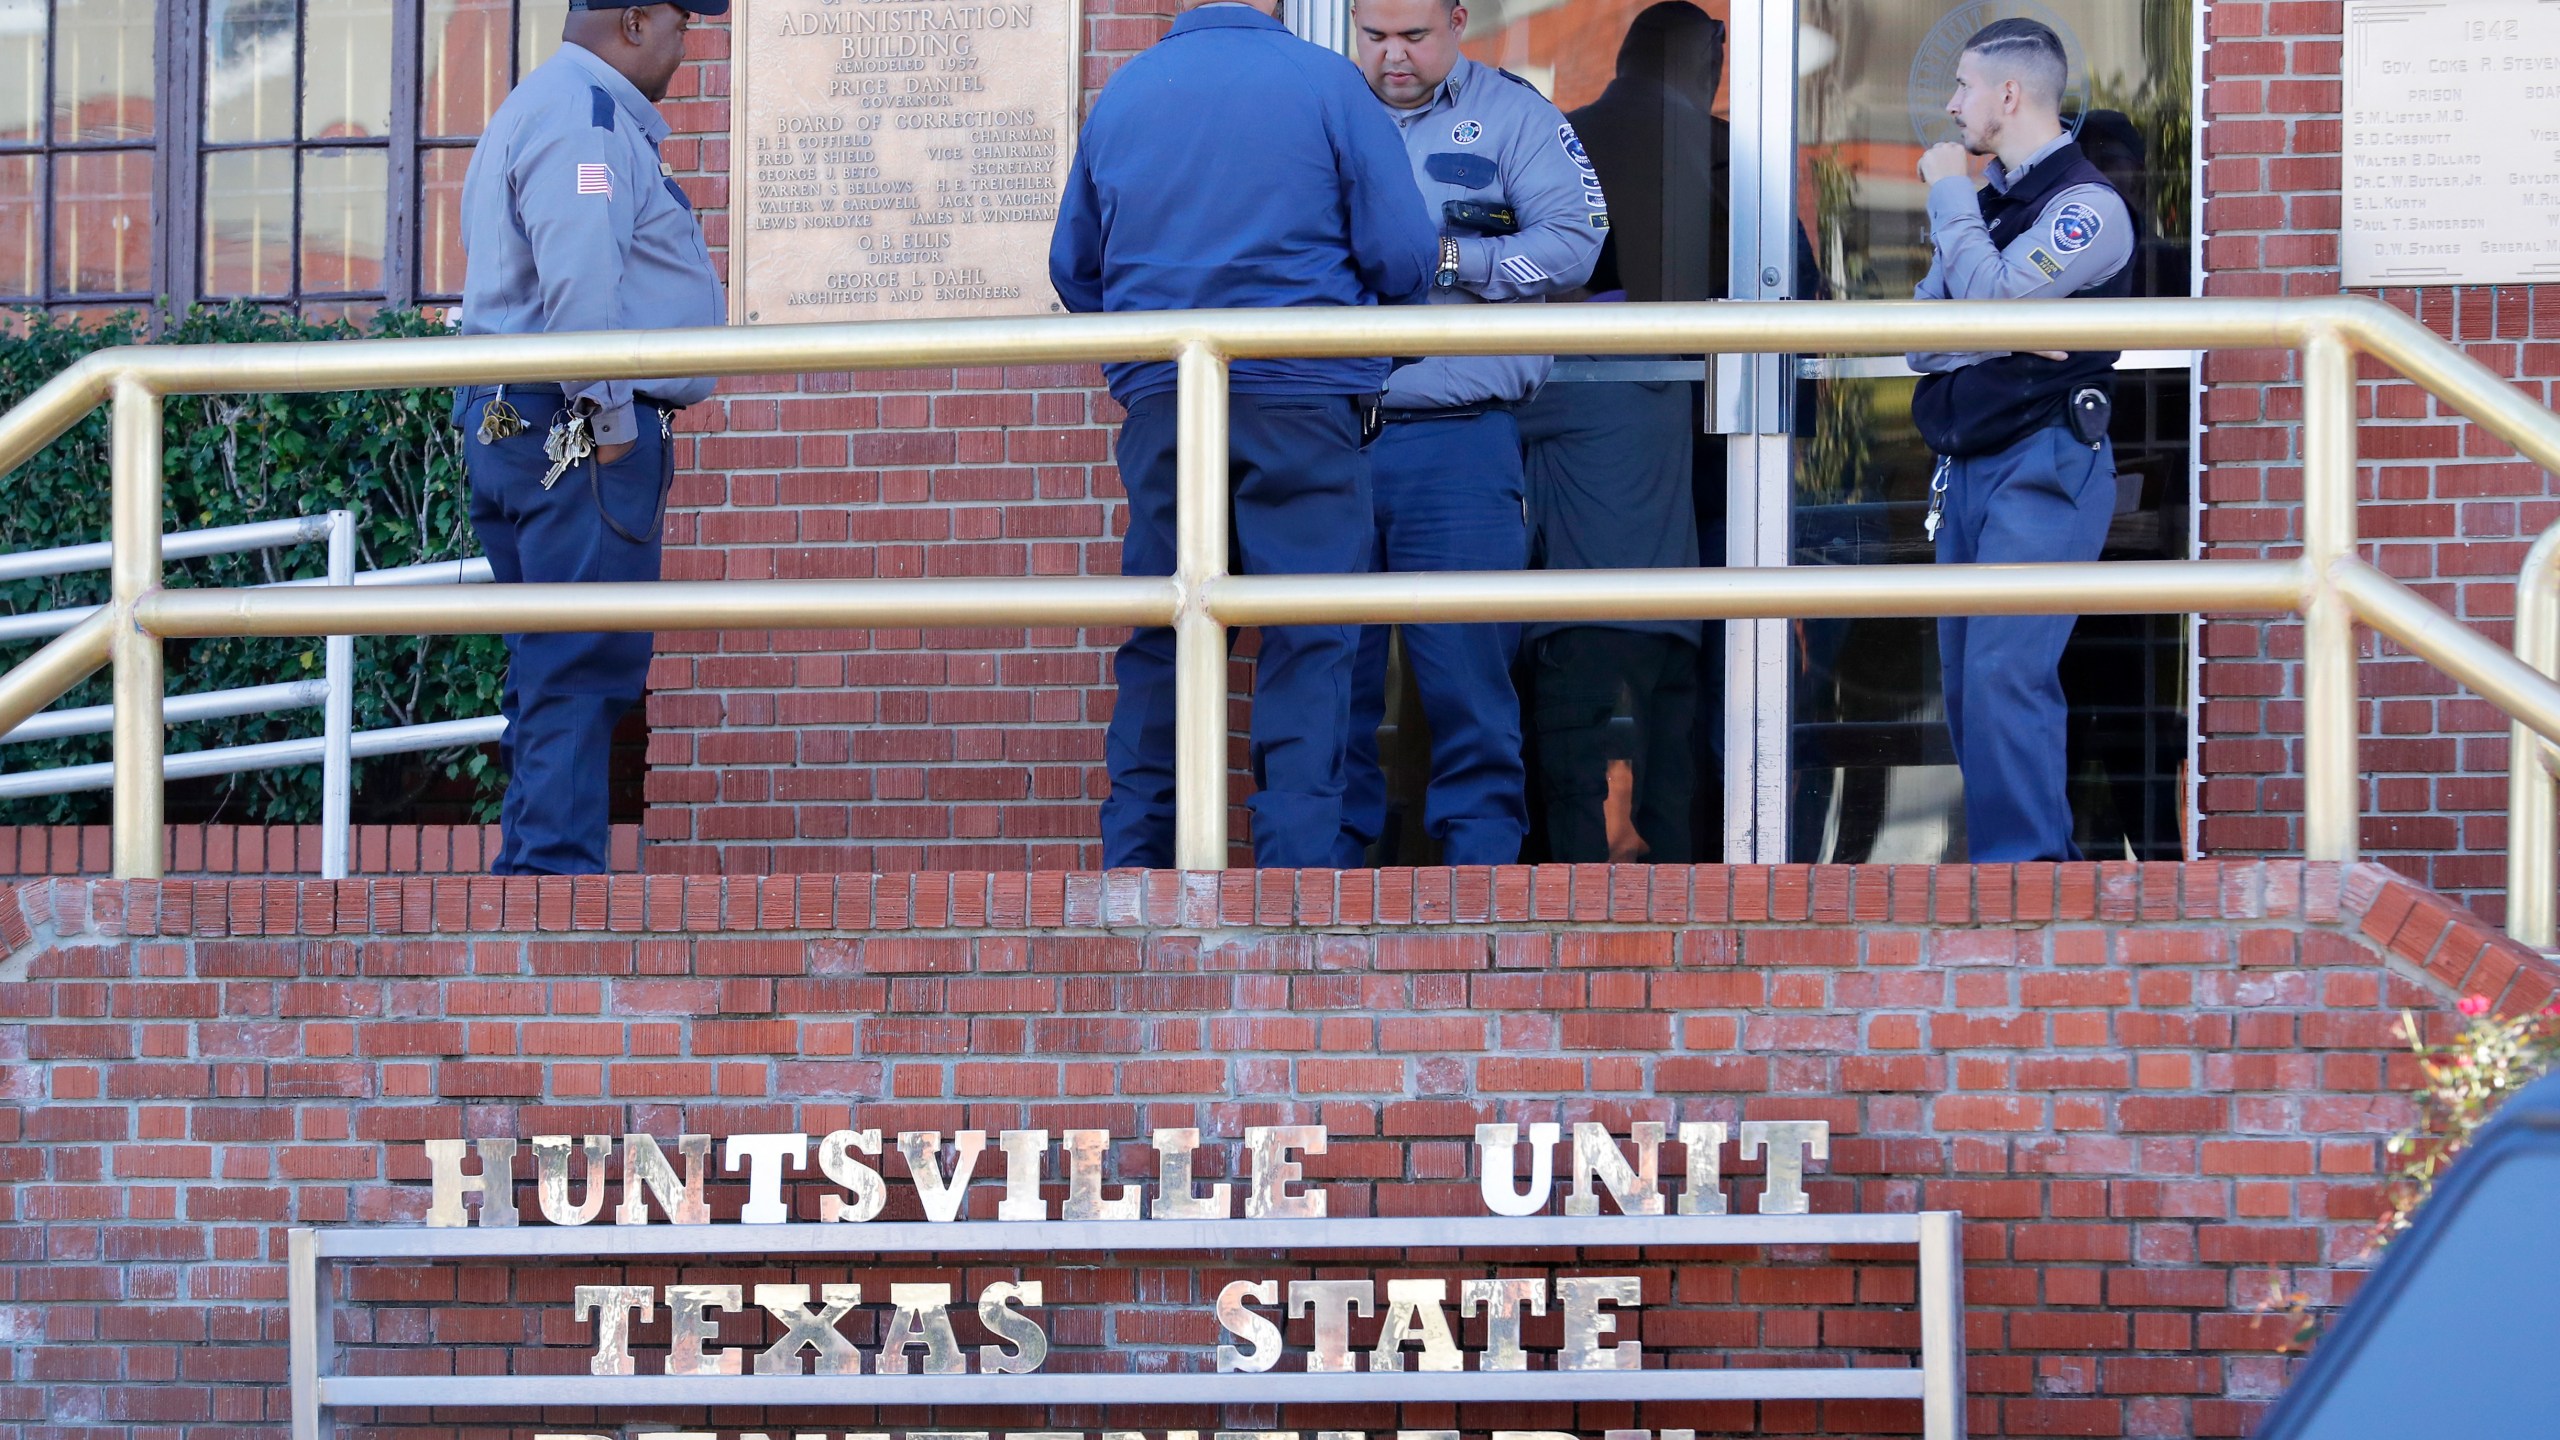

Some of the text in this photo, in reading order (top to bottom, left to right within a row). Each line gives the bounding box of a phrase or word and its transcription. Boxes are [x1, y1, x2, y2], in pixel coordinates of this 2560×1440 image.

[779, 5, 1032, 36] ADMINISTRATION
[2464, 19, 2519, 41] 1942
[841, 33, 971, 60] BUILDING
[834, 57, 979, 74] REMODELED 1957
[829, 76, 984, 96] PRICE DANIEL
[860, 93, 953, 108] GOVERNOR
[2408, 88, 2462, 102] PRISON
[777, 110, 1035, 133] BOARD OF CORRECTIONS
[756, 134, 872, 150] H. H. COFFIELD
[970, 128, 1055, 143] CHAIRMAN
[756, 151, 875, 166] FRED W. SHIELD
[926, 144, 1055, 160] VICE CHAIRMAN
[757, 166, 880, 181] GEORGE J. BETO
[971, 161, 1055, 175] SECRETARY
[756, 180, 913, 198] WARREN S. BELLOWS
[936, 177, 1056, 193] H. E. TREICHLER
[757, 197, 920, 214] WALTER W. CARDWELL
[938, 193, 1056, 208] JACK C. VAUGHN
[756, 214, 872, 231] LEWIS NORDYKE
[910, 208, 1056, 225] JAMES M. WINDHAM
[858, 233, 951, 250] O. B. ELLIS
[869, 251, 943, 265] DIRECTOR
[825, 268, 986, 289] GEORGE L. DAHL
[787, 286, 1021, 305] ARCHITECTS AND ENGINEERS
[425, 1120, 1829, 1228] HUNTSVILLE UNIT
[574, 1276, 1641, 1375] TEXAS STATE
